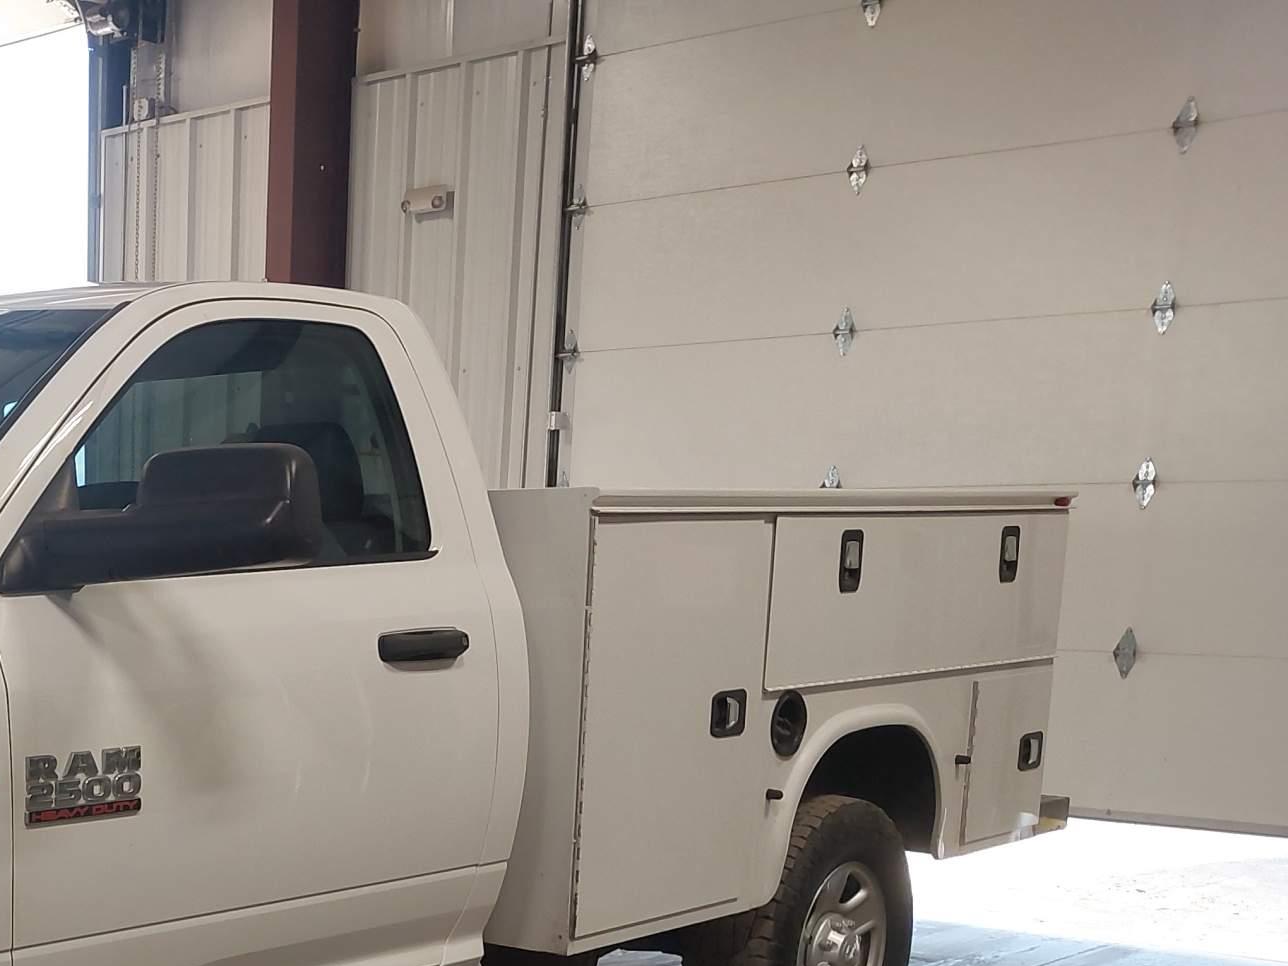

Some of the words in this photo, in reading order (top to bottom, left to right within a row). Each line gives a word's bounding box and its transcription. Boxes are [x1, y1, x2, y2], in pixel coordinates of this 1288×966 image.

[25, 746, 142, 781] RAM
[25, 772, 142, 812] 2500
[31, 805, 89, 822] HEAVY
[92, 799, 138, 816] DUTY
